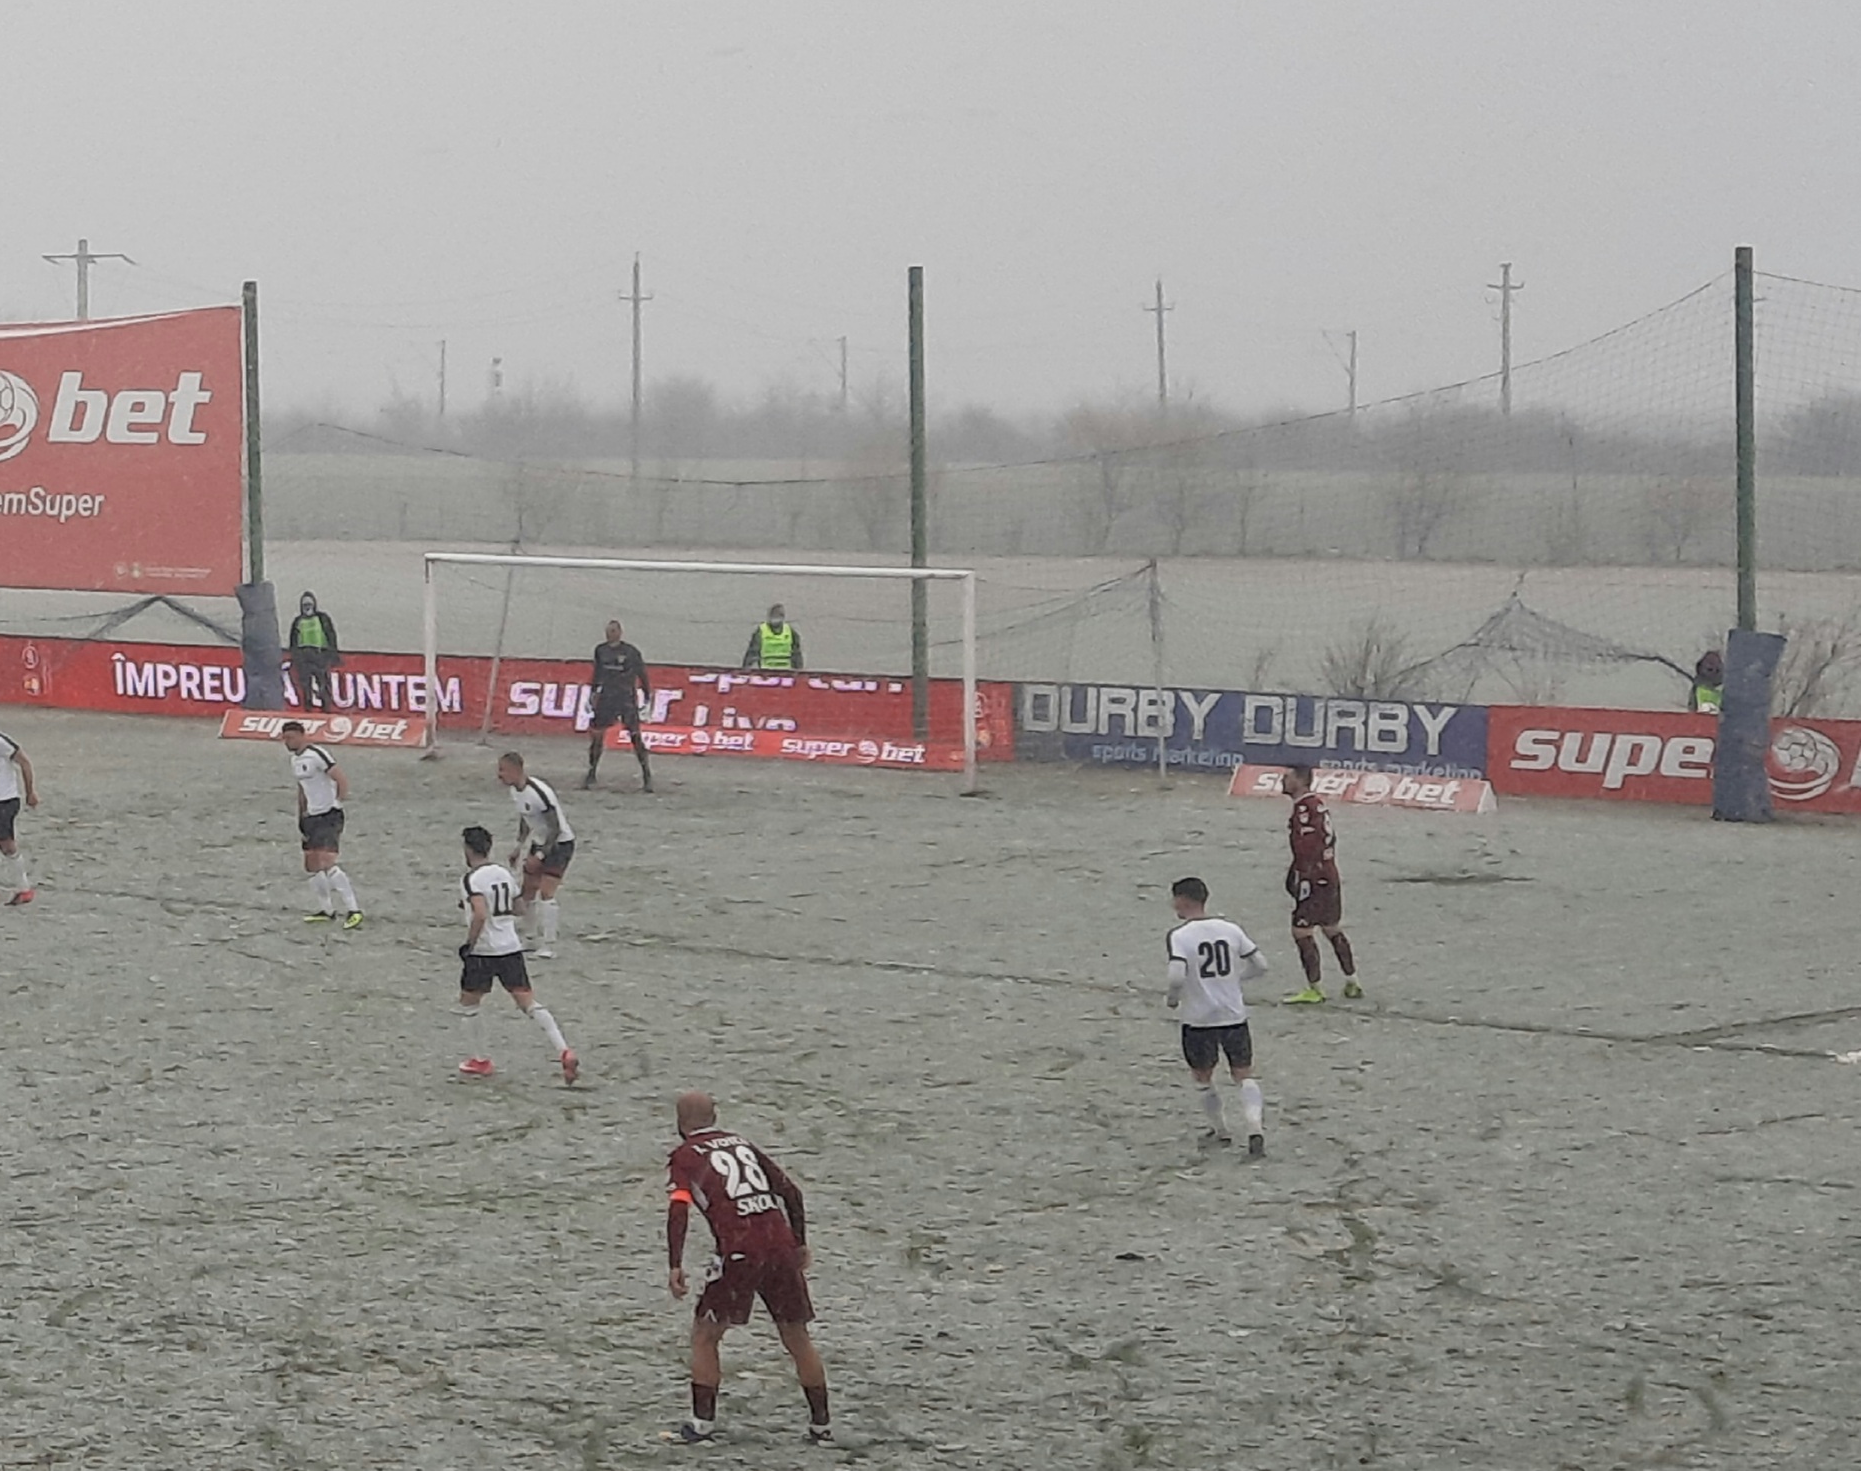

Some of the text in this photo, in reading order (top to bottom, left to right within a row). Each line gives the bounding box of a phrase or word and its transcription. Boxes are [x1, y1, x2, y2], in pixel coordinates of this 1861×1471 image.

[49, 371, 212, 444] bet
[309, 671, 462, 714] UNTEM
[353, 718, 409, 740] bet
[1023, 683, 1223, 741] DURBY
[1243, 694, 1459, 756] DURBY
[780, 738, 926, 763] super bet
[1510, 729, 1715, 790] supe
[1392, 777, 1461, 805] bet
[491, 882, 512, 917] 11
[1198, 939, 1231, 979] 20
